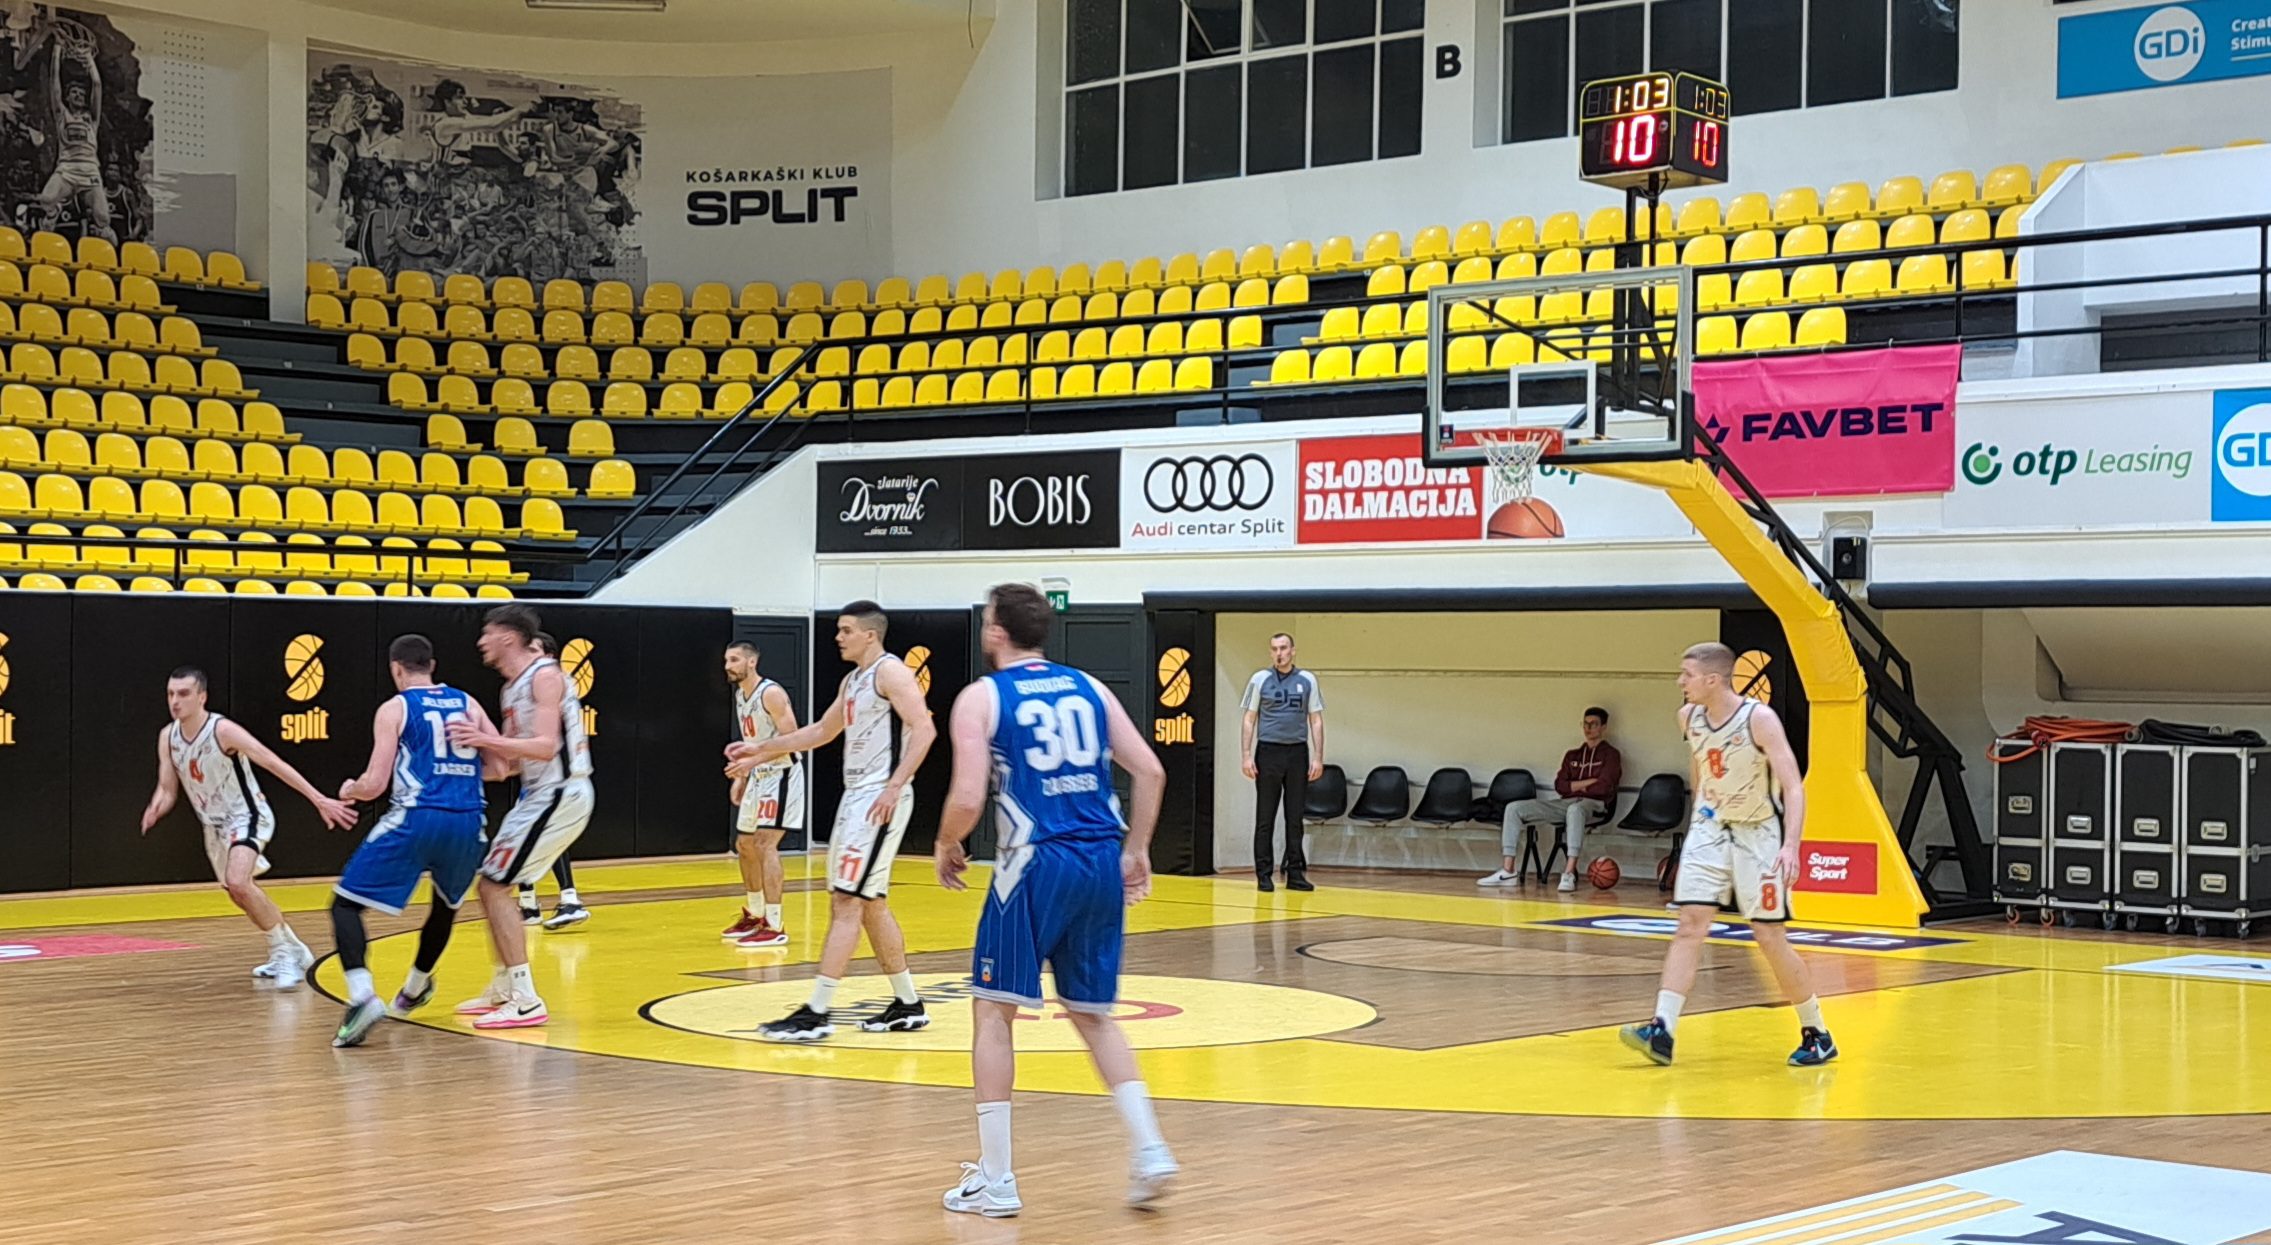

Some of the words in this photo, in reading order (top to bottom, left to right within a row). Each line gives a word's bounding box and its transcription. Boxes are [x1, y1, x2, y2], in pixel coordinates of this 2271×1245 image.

[2139, 26, 2200, 60] GDi
[1436, 44, 1462, 80] B
[1614, 78, 1669, 113] 1:03
[1694, 84, 1728, 119] 1:03
[1614, 114, 1656, 163] 10
[1694, 121, 1718, 168] 10
[686, 167, 805, 183] KOŠARKAŠKI
[813, 166, 858, 180] KLUB
[687, 186, 859, 226] SPLIT
[1742, 402, 1944, 442] FAVBET
[1305, 457, 1471, 490] SLOBODNA
[2013, 443, 2078, 485] otp
[2084, 444, 2193, 479] Leasing
[840, 477, 939, 522] Dvornik
[989, 474, 1092, 527] BOBIS
[1304, 488, 1477, 521] DALMACIJA
[1131, 521, 1174, 537] Audi
[1177, 522, 1236, 536] centar
[1241, 517, 1285, 537] Split
[281, 706, 330, 743] split
[1014, 694, 1101, 772] 30
[1155, 712, 1195, 745] split
[757, 798, 778, 819] 20
[1808, 852, 1850, 867] Super
[1810, 866, 1848, 881] Sport
[1761, 883, 1776, 912] 8
